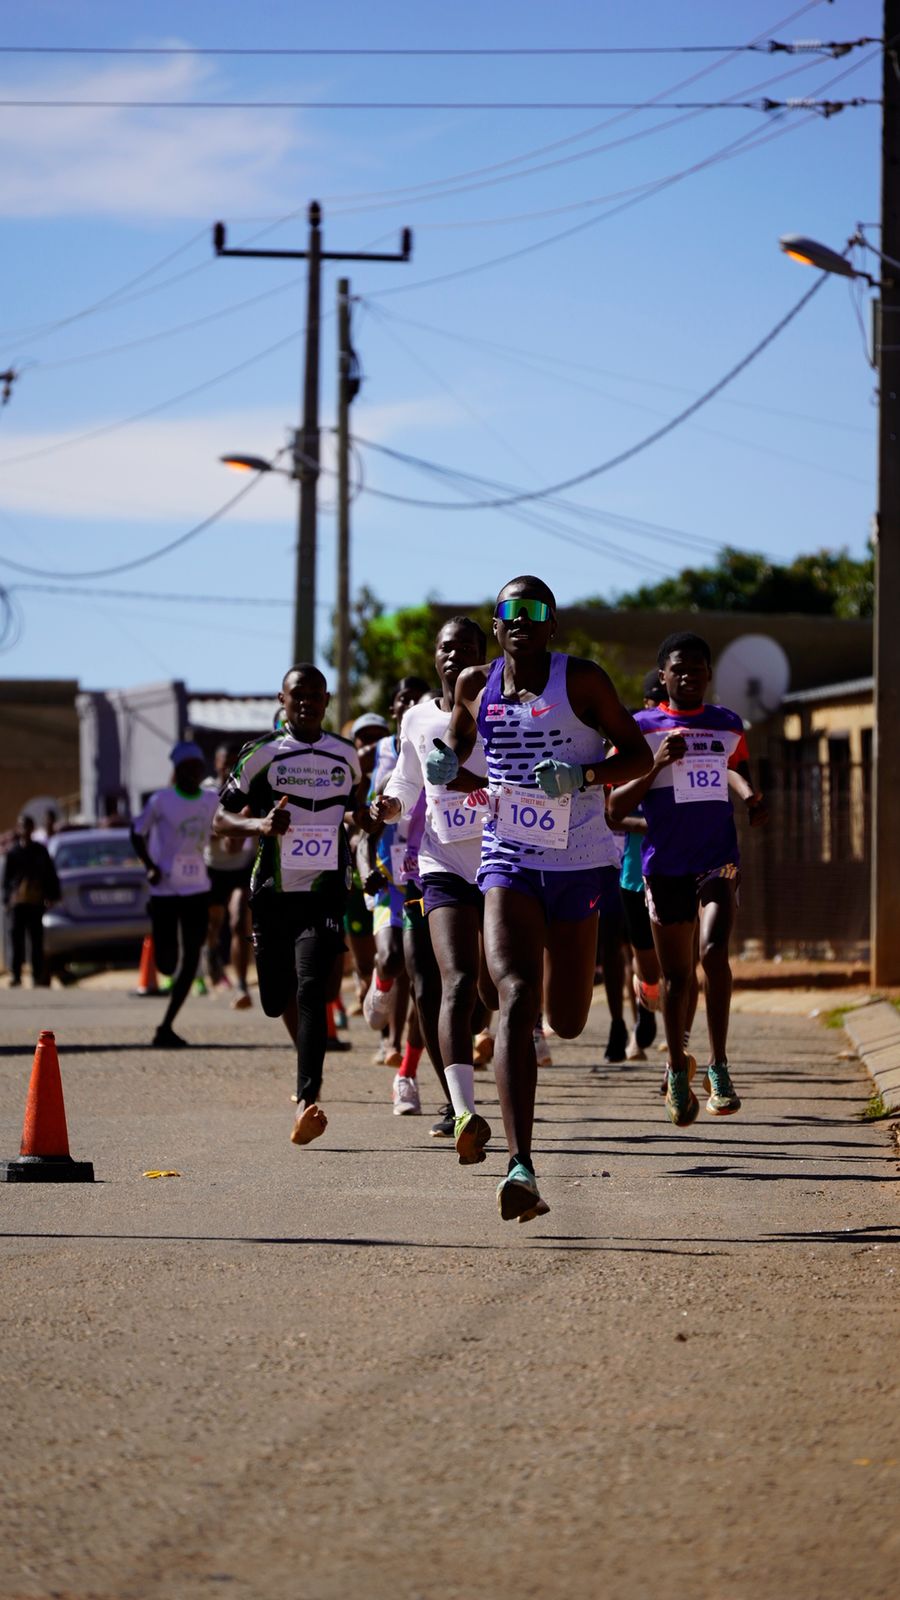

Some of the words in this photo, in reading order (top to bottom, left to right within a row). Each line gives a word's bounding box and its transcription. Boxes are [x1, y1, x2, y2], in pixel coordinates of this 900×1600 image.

[303, 767, 329, 775] MUTUAL
[687, 770, 721, 788] 182
[443, 808, 477, 828] 167
[511, 804, 555, 831] 106
[291, 839, 333, 857] 207
